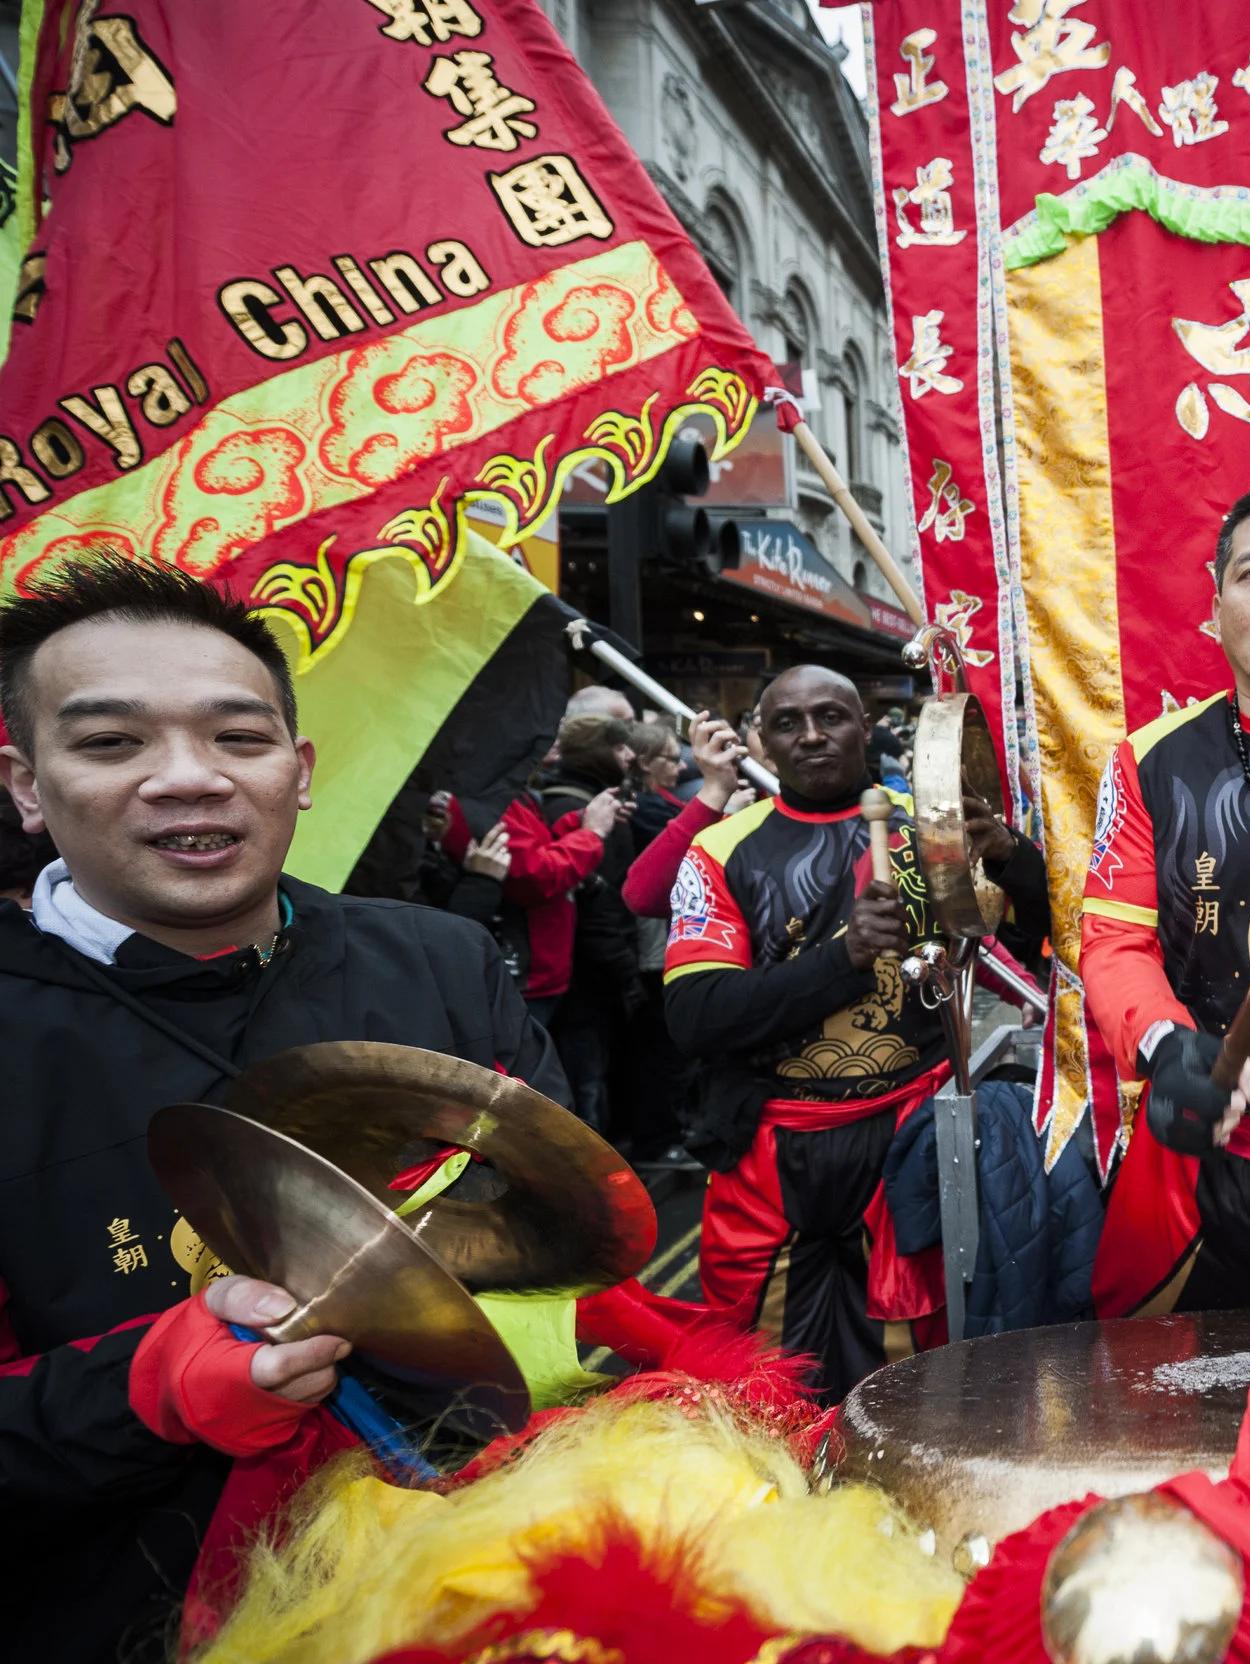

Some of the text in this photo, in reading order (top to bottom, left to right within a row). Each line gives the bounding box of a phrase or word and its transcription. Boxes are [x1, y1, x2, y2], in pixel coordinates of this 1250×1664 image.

[217, 239, 491, 361] China
[1190, 850, 1222, 937] 皇朝
[106, 1217, 149, 1275] 皇朝
